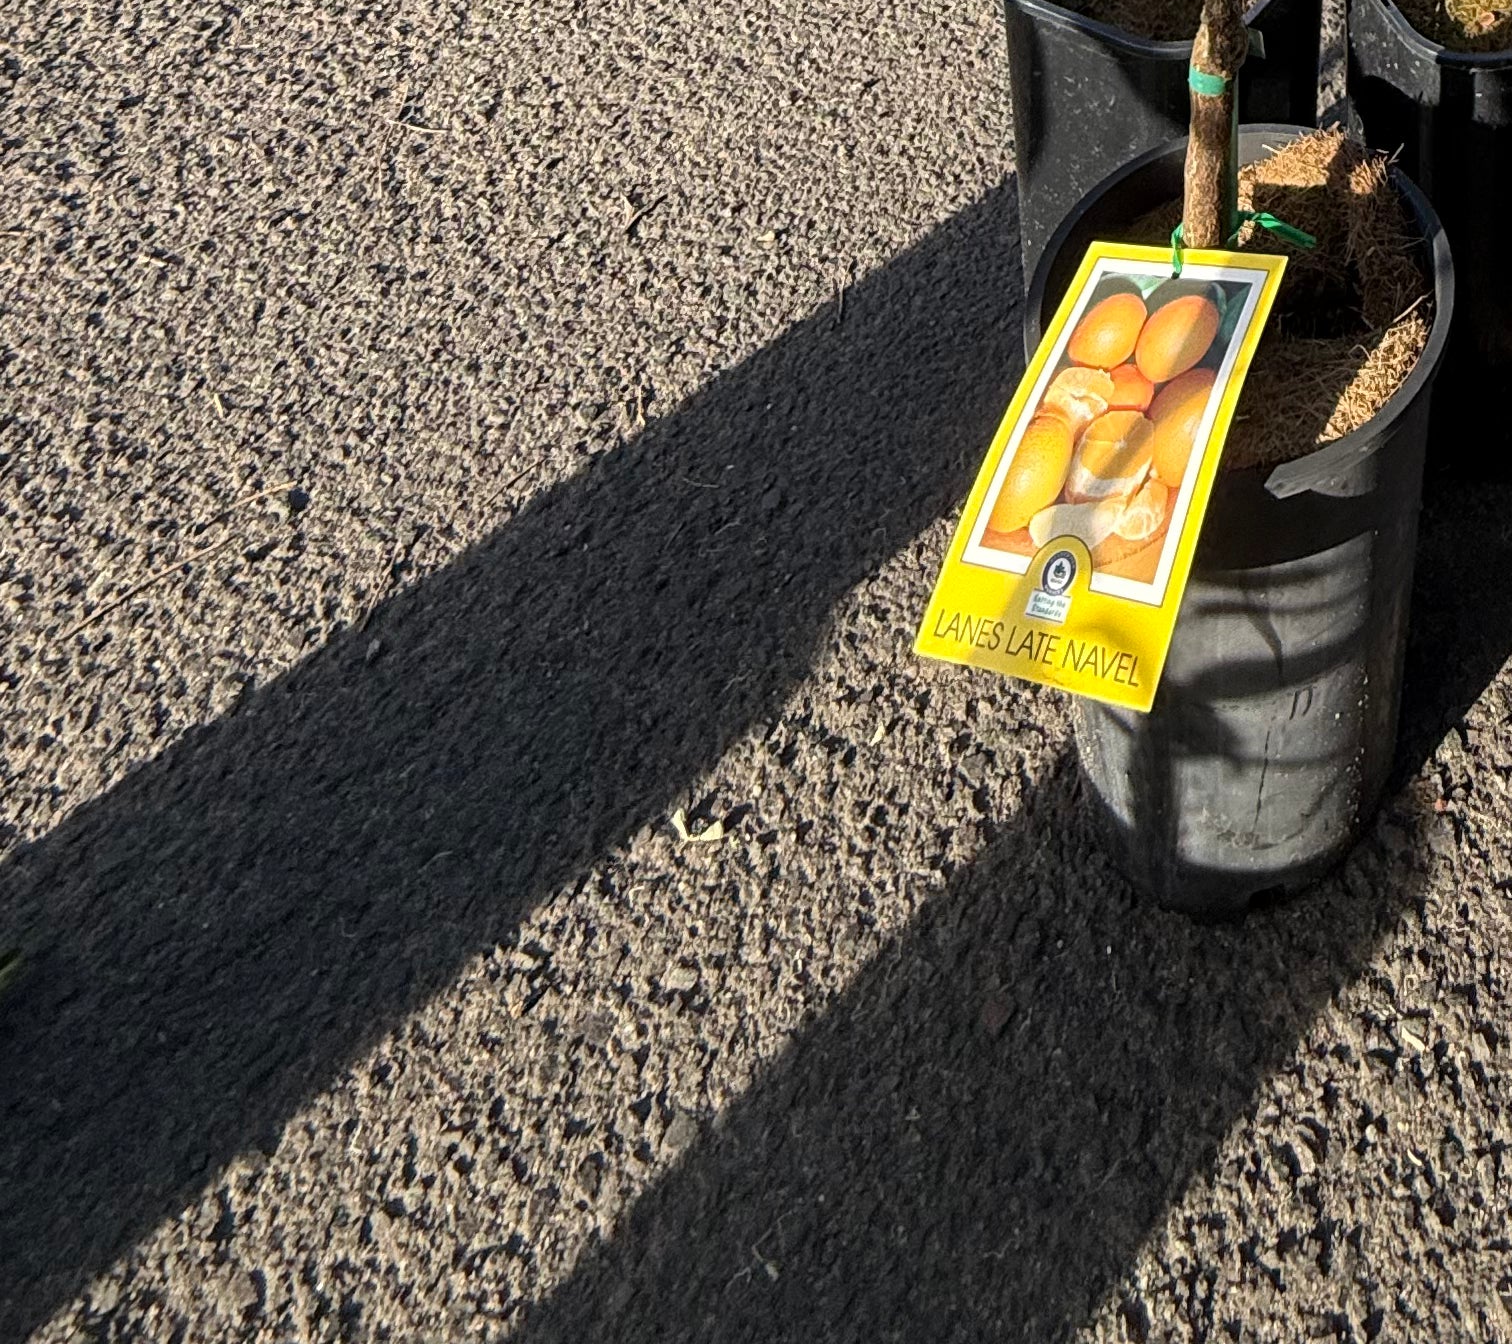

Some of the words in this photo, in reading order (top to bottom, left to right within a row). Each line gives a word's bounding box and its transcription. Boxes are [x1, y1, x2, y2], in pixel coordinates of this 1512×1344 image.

[933, 608, 1004, 651] LANES
[1005, 625, 1061, 666] LATE
[1061, 639, 1140, 688] NAVEL
